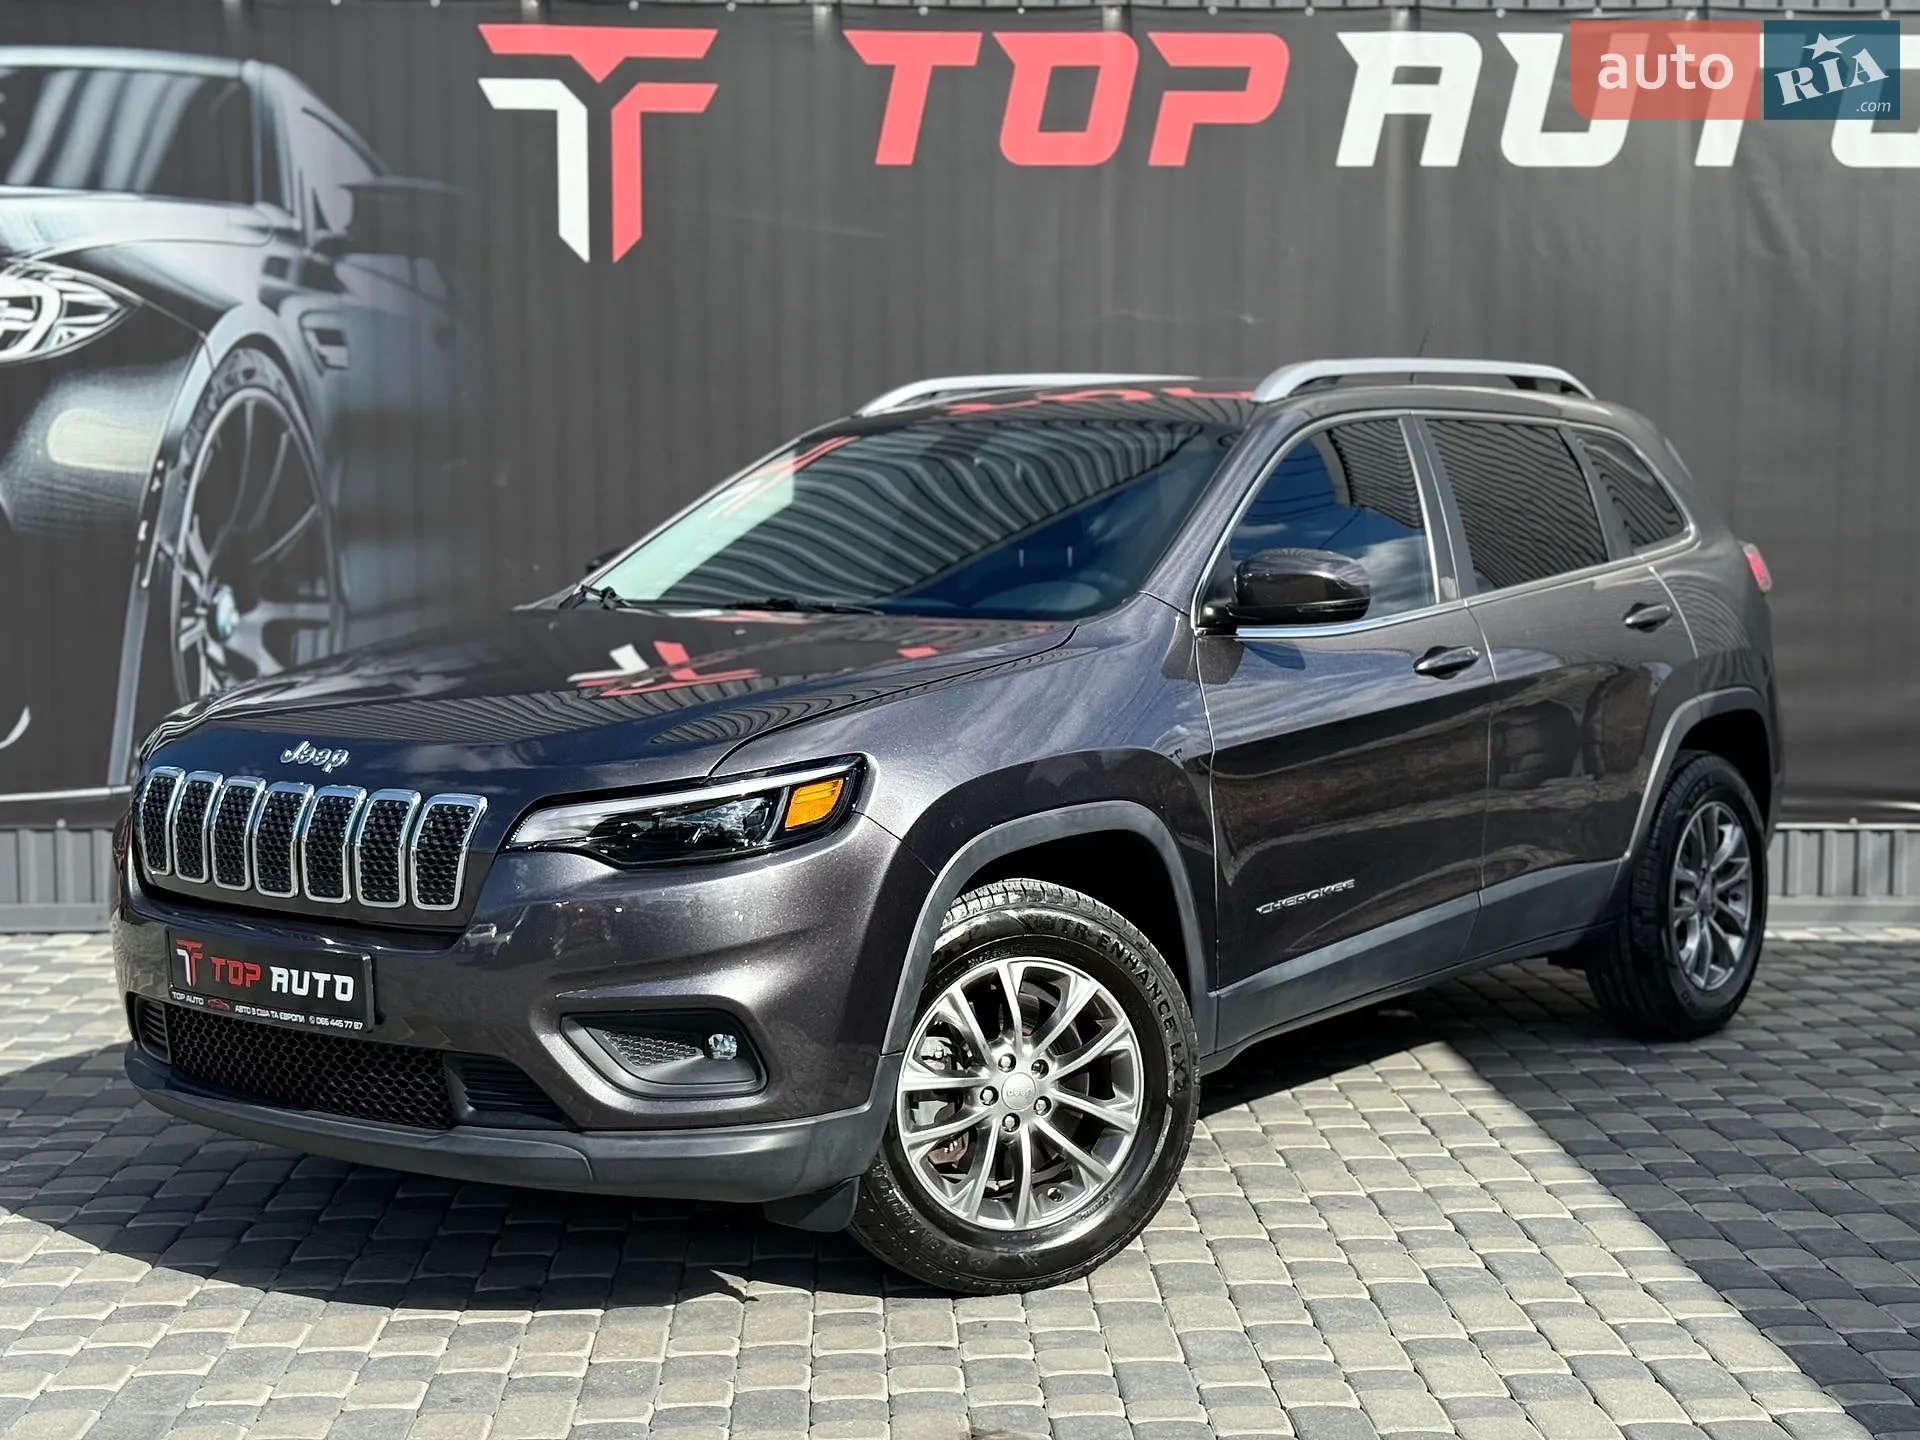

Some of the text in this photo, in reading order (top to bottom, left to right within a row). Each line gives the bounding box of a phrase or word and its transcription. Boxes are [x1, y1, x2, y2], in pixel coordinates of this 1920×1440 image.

[843, 30, 1290, 167] TOP
[280, 740, 349, 773] Jeep
[1256, 879, 1355, 915] CHEROKEE
[172, 991, 204, 1006] TOP AUTO
[211, 956, 354, 1002] TOP AUTO
[1097, 932, 1178, 1030] ENHANCE
